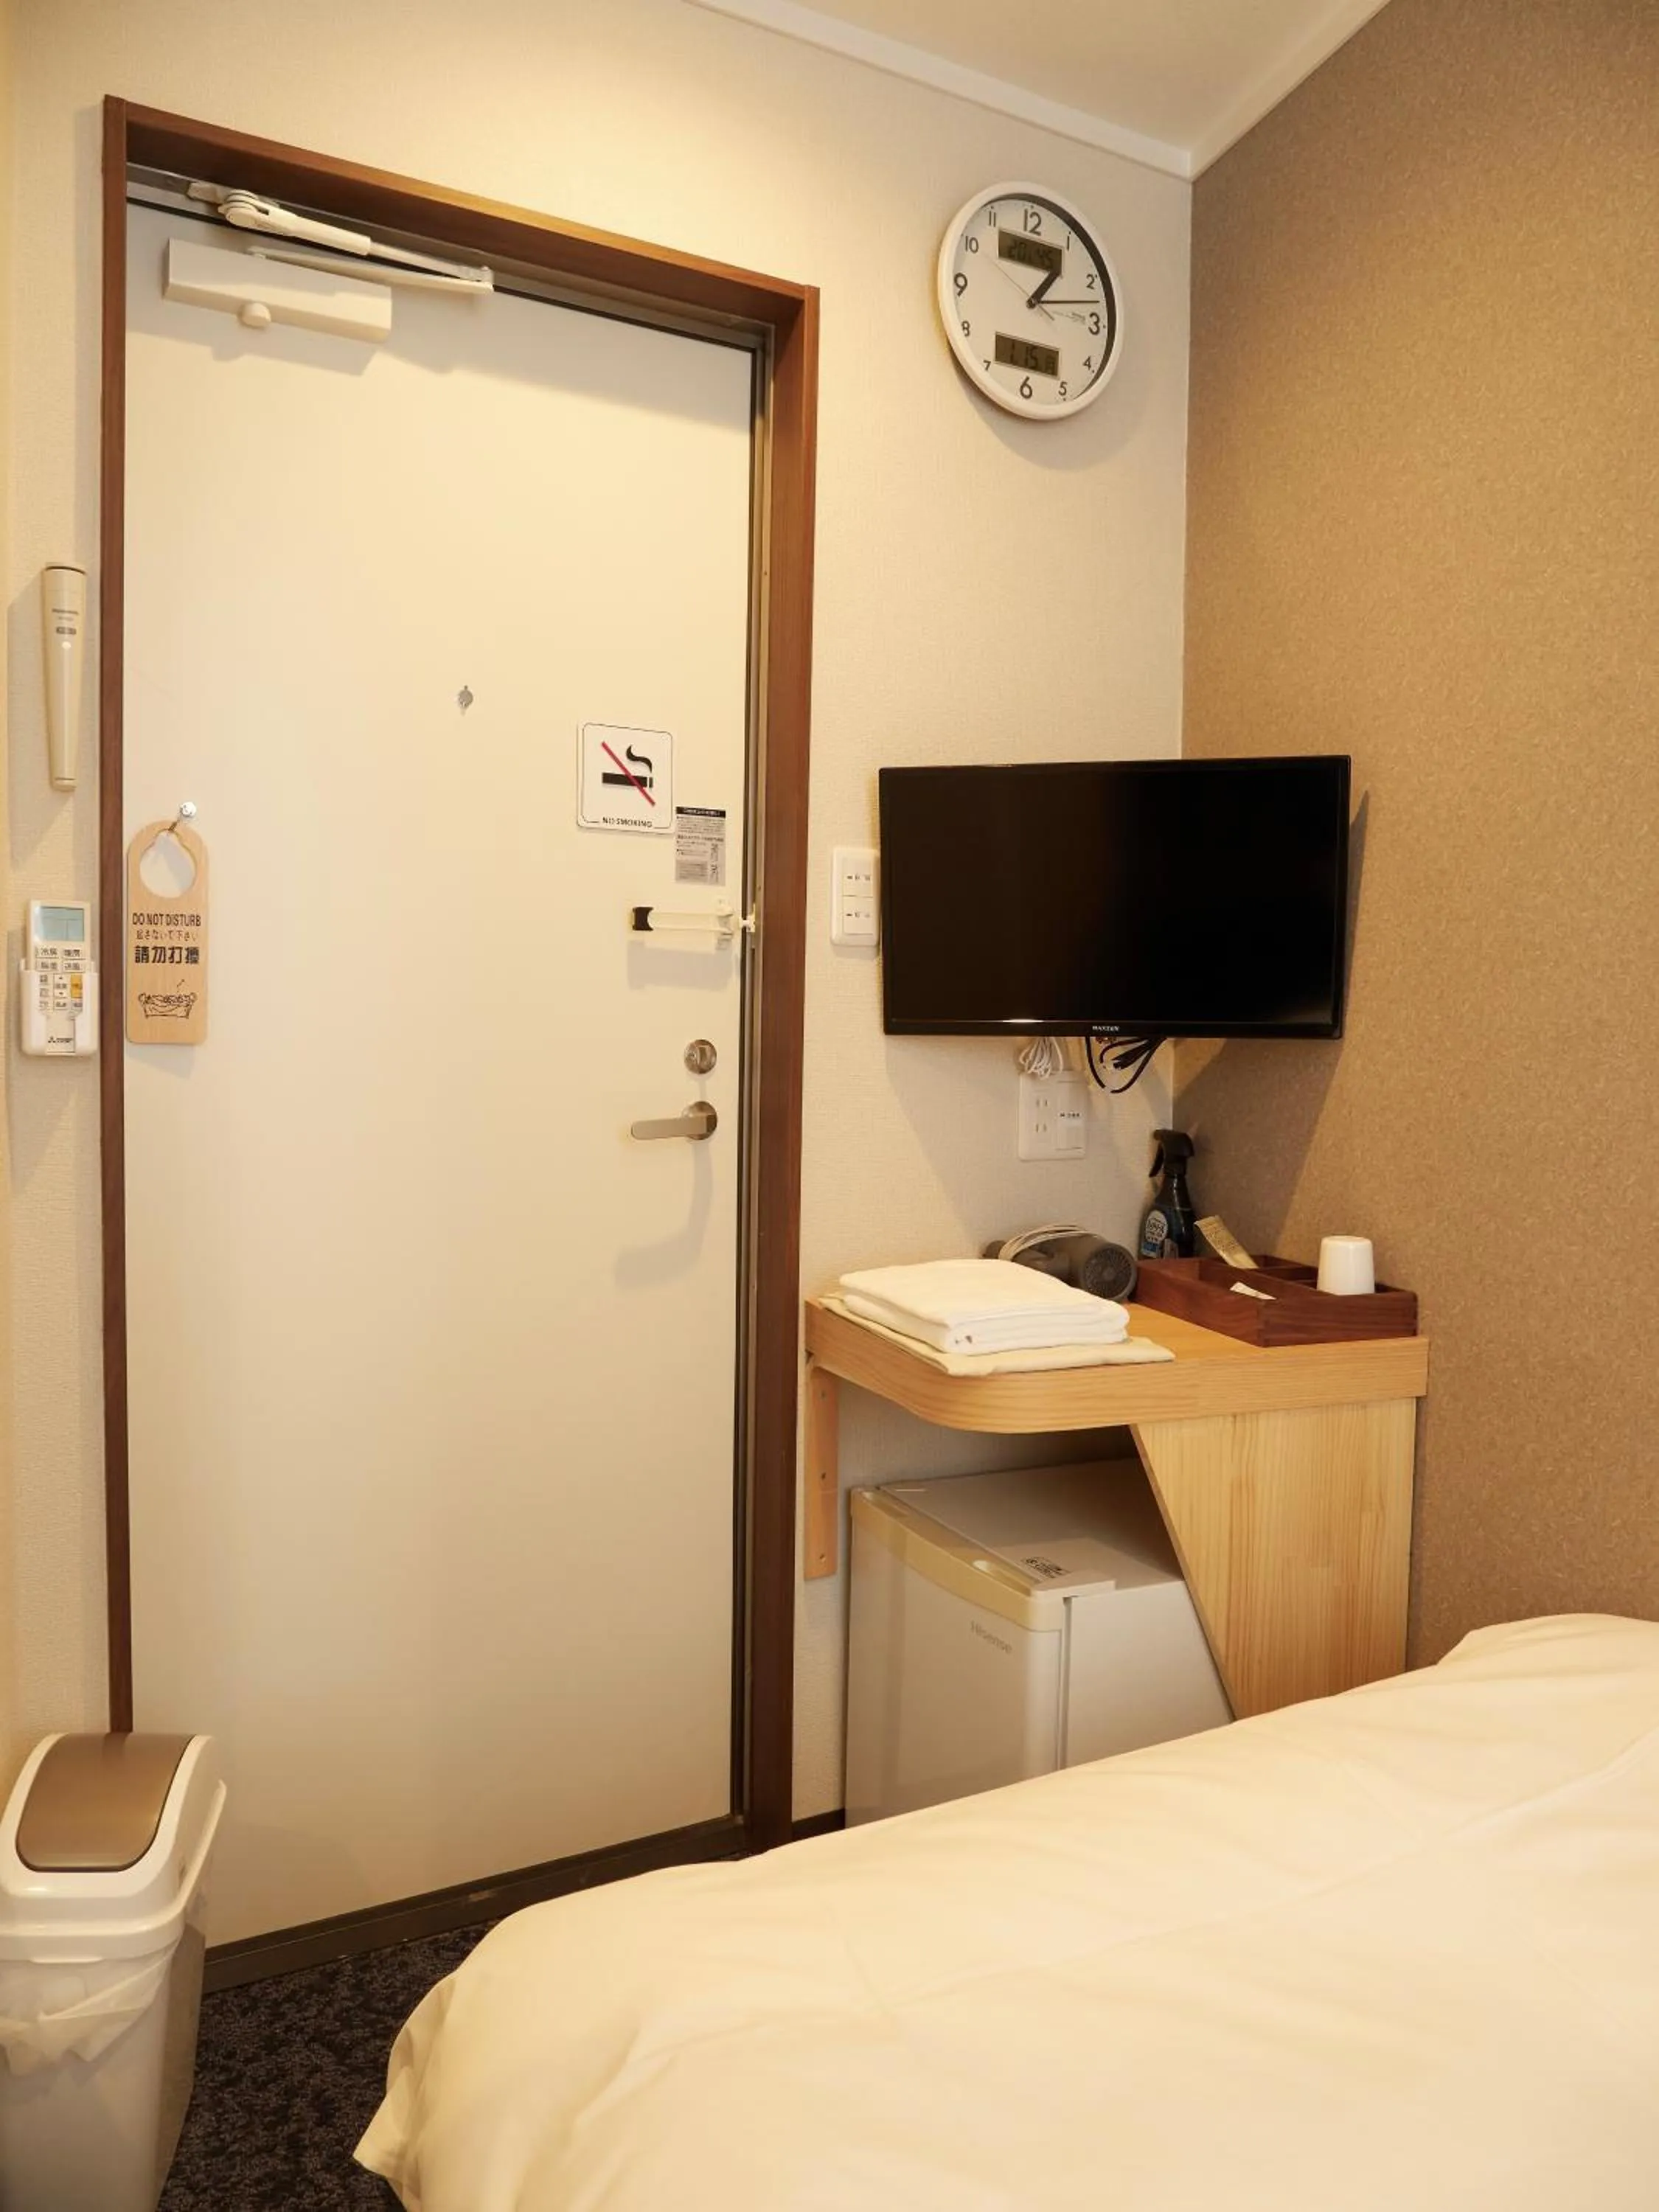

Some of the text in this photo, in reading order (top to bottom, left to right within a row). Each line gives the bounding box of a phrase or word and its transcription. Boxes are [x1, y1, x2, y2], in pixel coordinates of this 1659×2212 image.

[988, 211, 997, 228] 11
[1023, 209, 1042, 235] 12
[964, 235, 979, 254] 10
[954, 272, 968, 296] 9
[1086, 274, 1096, 290] 2
[961, 321, 970, 337] 8
[1088, 313, 1101, 335] 3
[983, 359, 992, 371] 7
[1083, 356, 1092, 370] 4
[1020, 377, 1033, 399] 6
[1058, 381, 1067, 397] 5
[602, 816, 653, 828] NO SMOKING
[132, 912, 201, 927] DO NOT DISTURB
[970, 1620, 1013, 1655] Hisense
